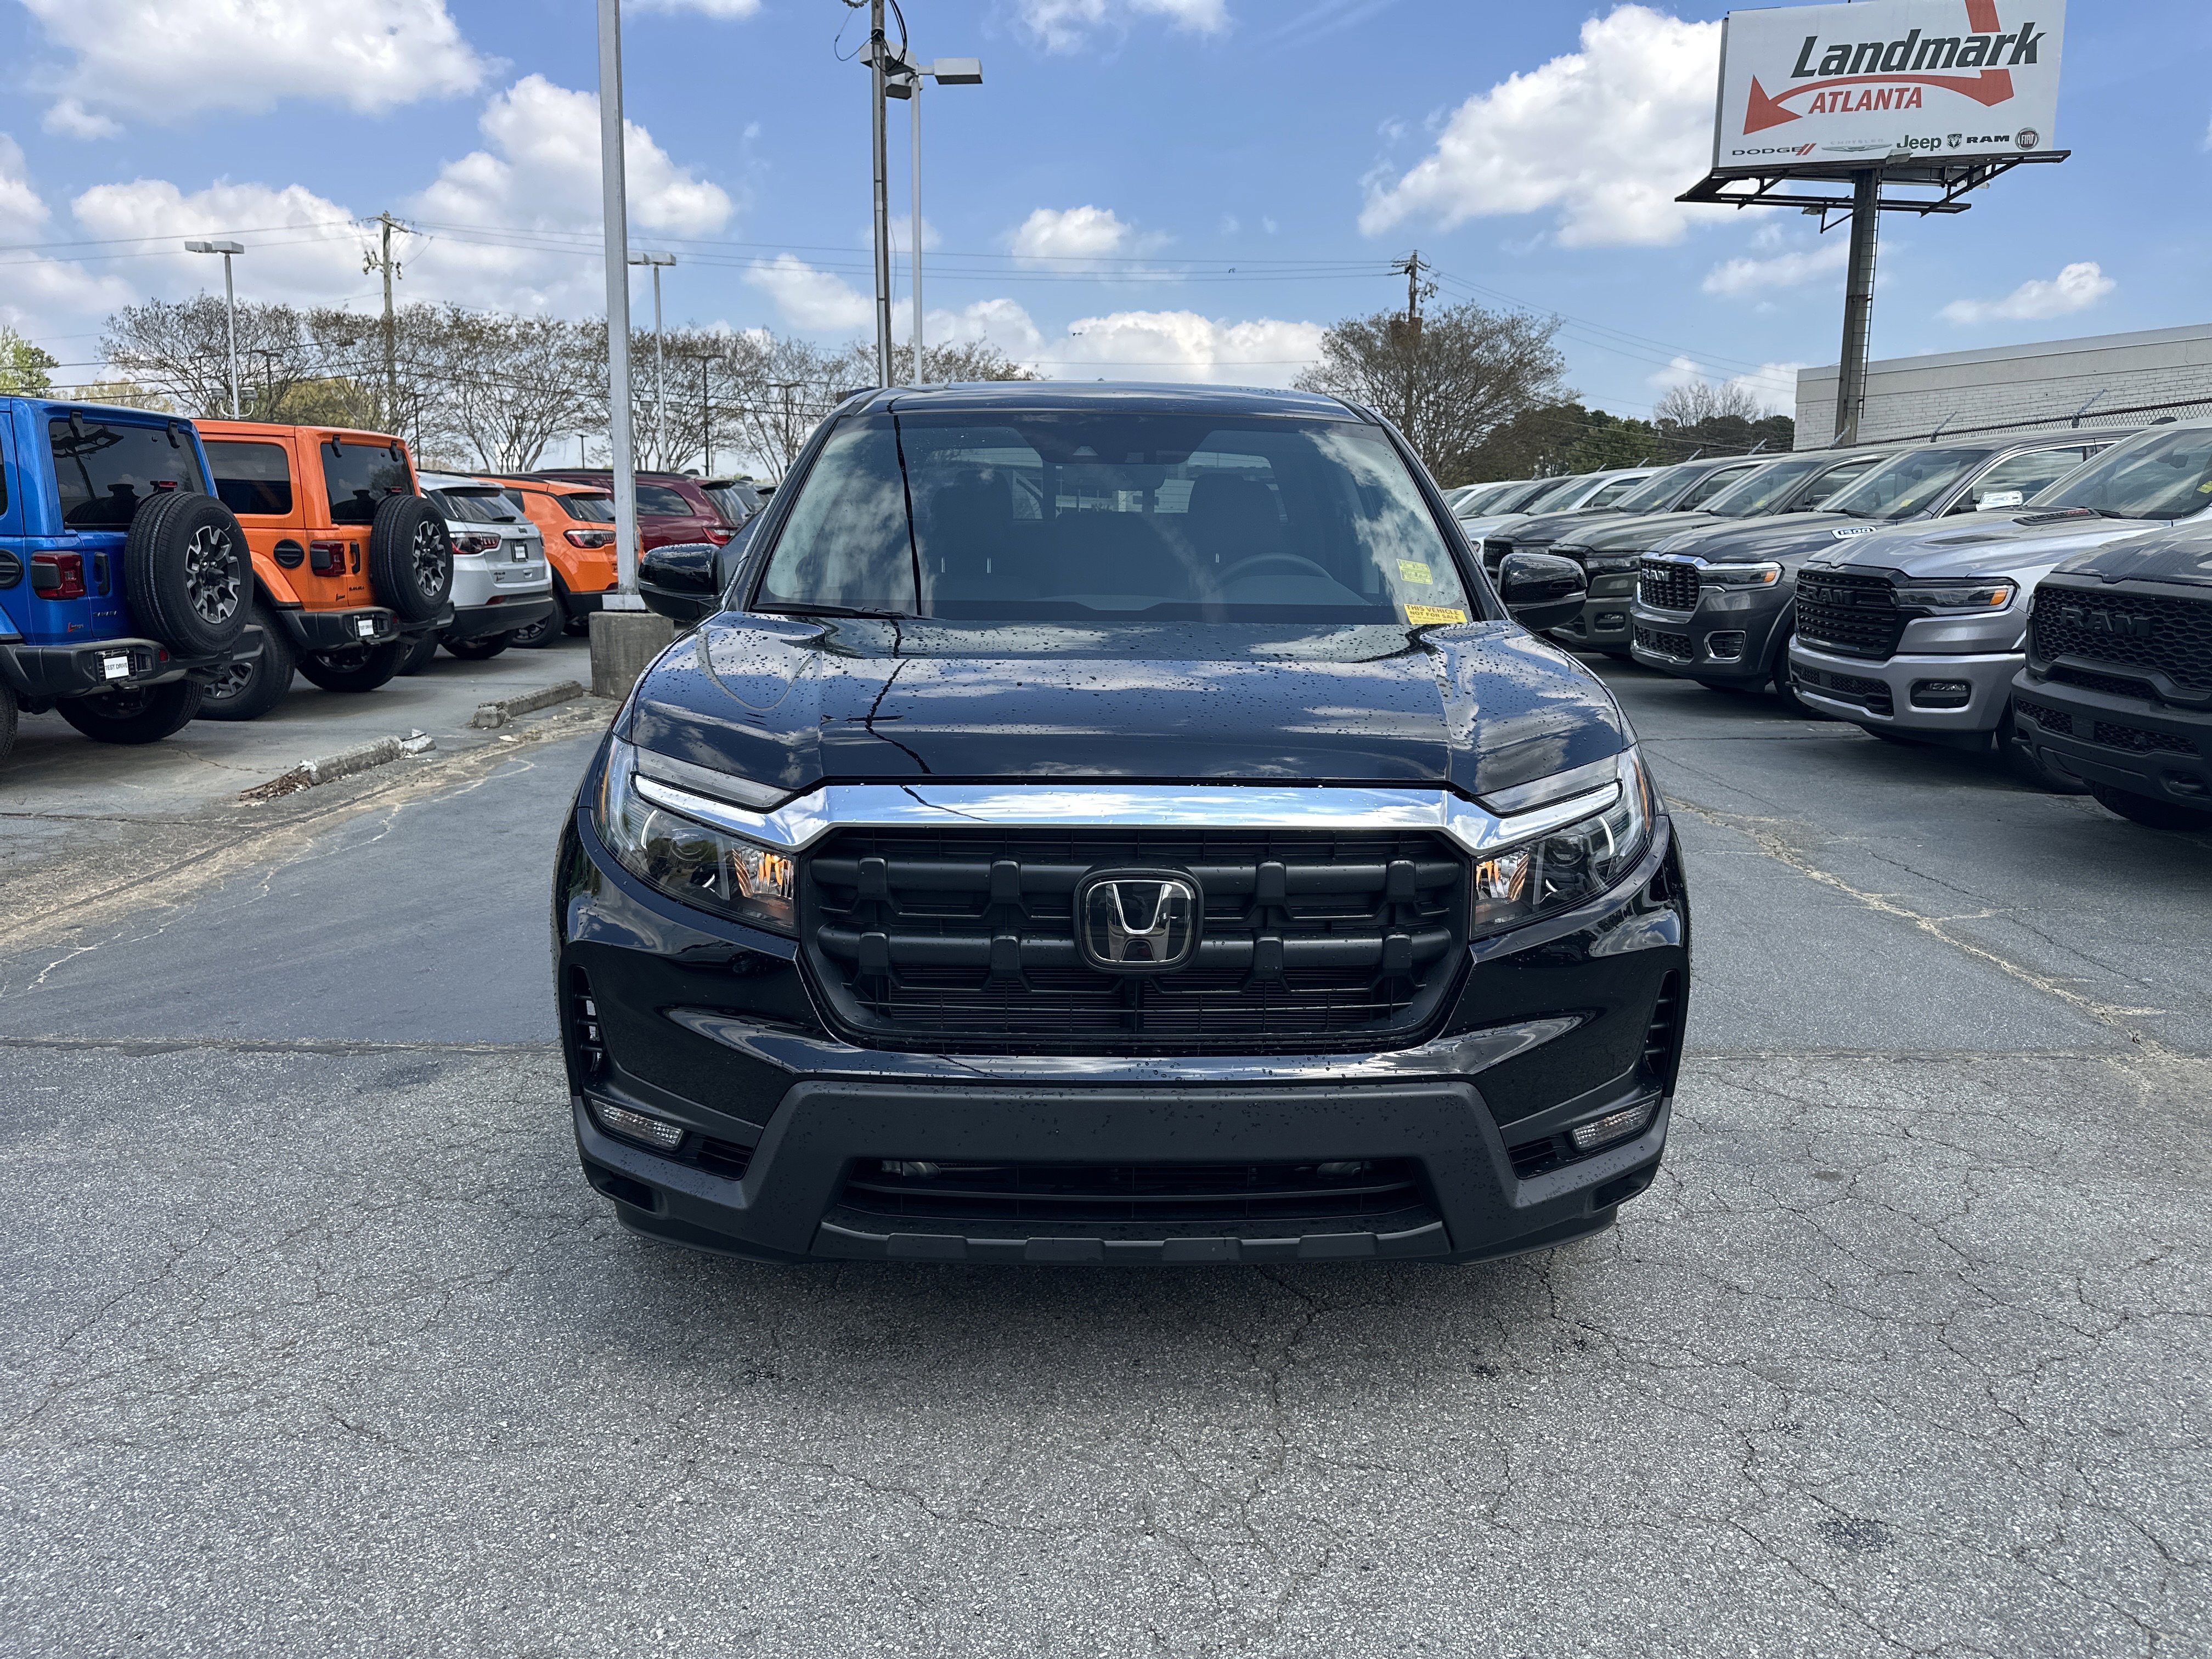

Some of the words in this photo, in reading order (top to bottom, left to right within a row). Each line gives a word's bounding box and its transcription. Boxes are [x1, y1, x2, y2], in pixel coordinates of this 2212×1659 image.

[1791, 22, 2047, 78] Landmark
[1808, 87, 1922, 114] ATLANTA
[1897, 134, 1942, 151] Jeep
[1966, 135, 2010, 144] RAM
[2021, 134, 2035, 145] FIAT
[1732, 146, 1804, 156] DODGE
[1641, 568, 1669, 582] RAM
[1806, 585, 1855, 604] RAM
[1426, 606, 1459, 615] VEHICLE
[2061, 606, 2151, 637] RAM
